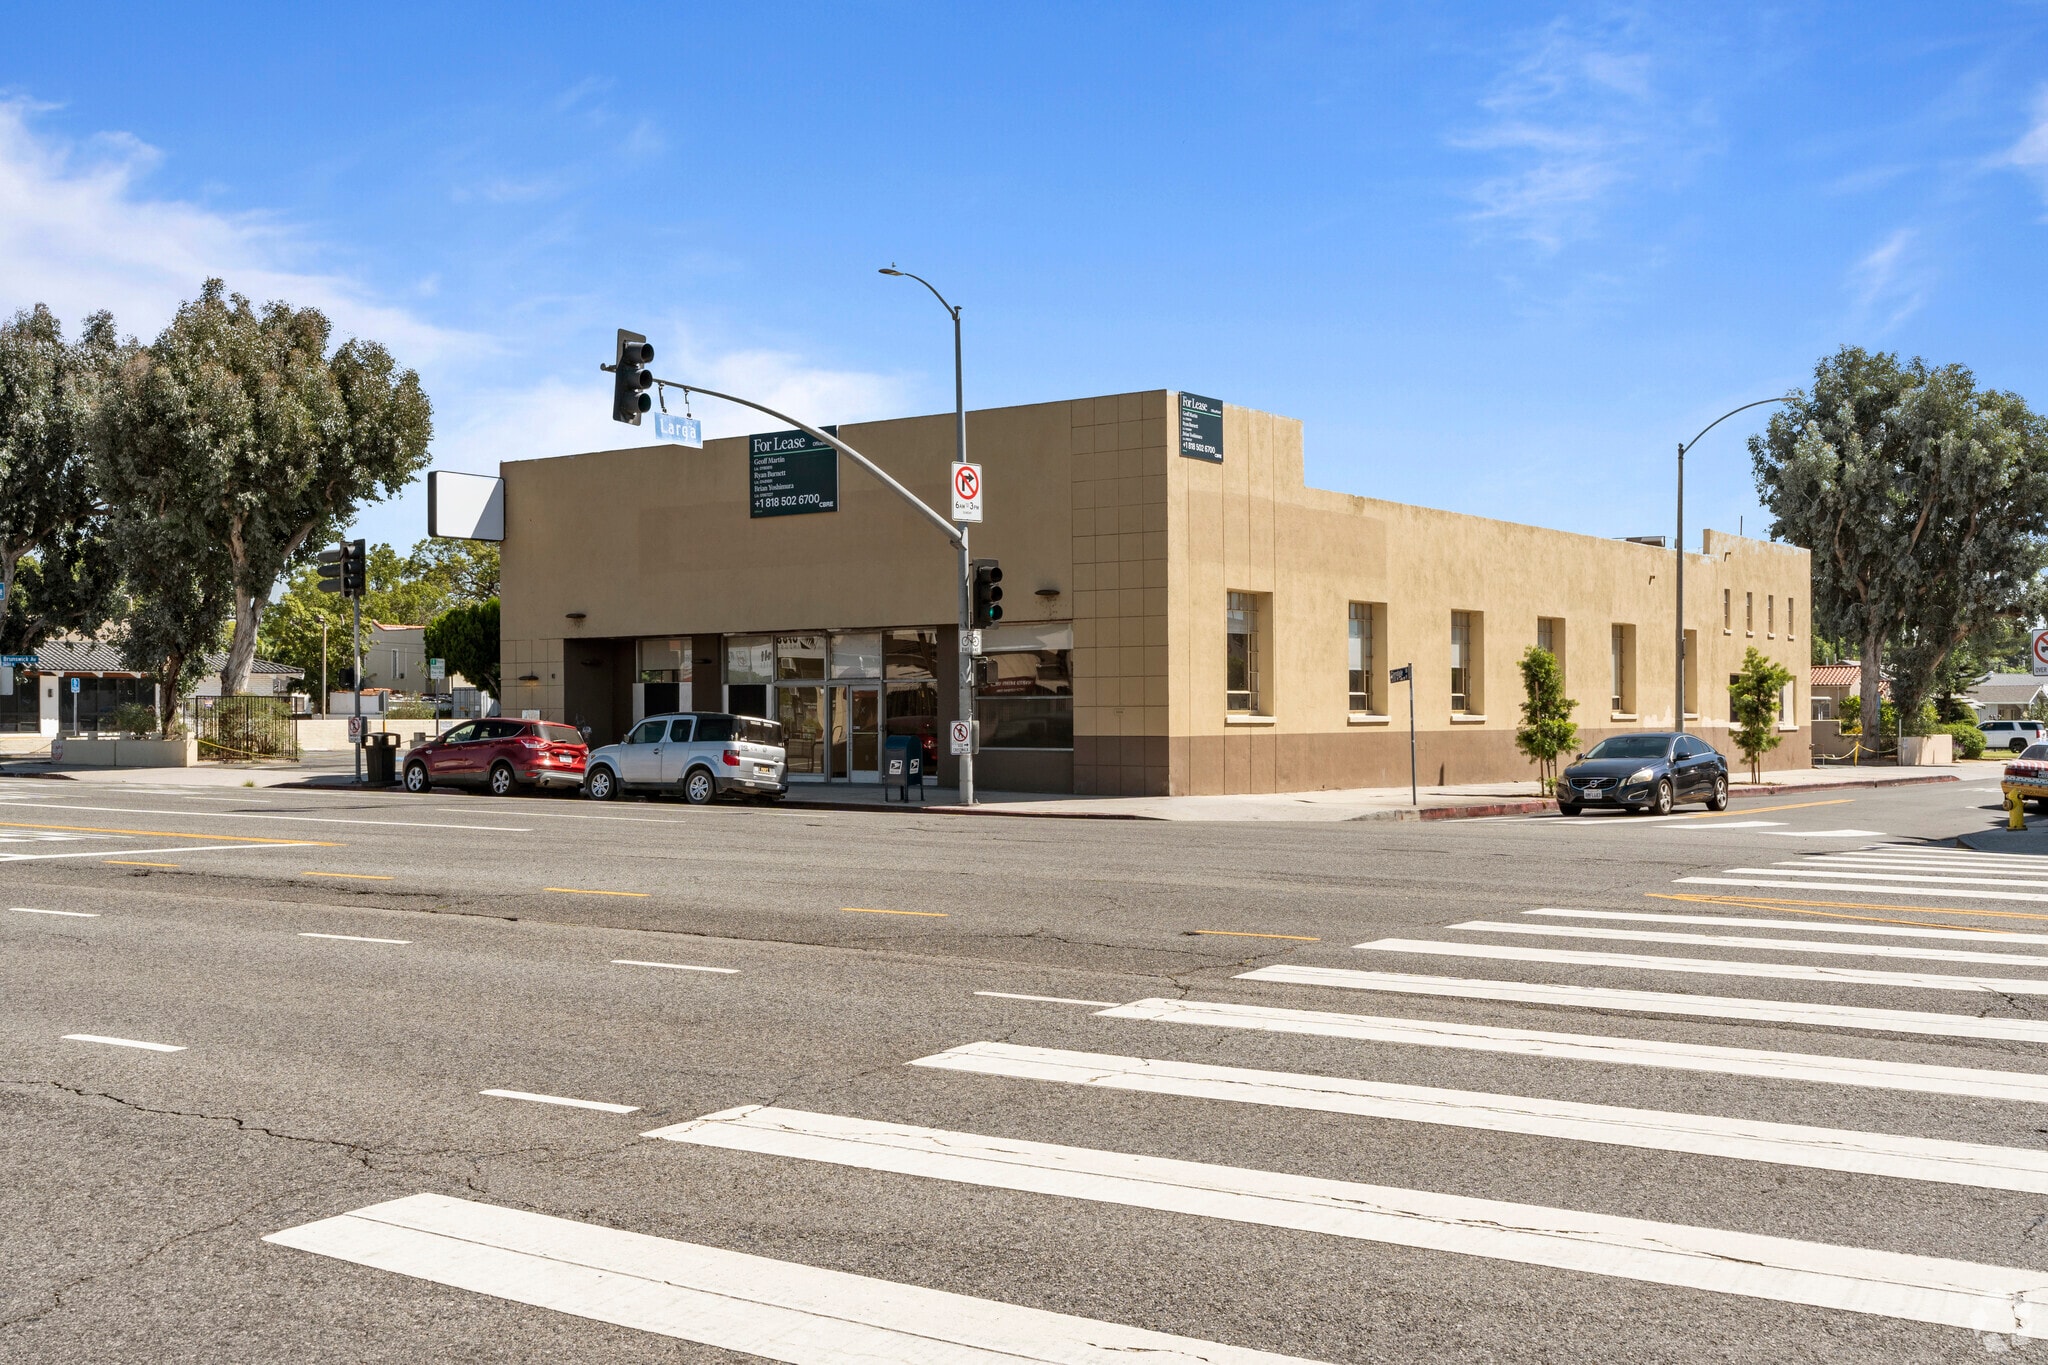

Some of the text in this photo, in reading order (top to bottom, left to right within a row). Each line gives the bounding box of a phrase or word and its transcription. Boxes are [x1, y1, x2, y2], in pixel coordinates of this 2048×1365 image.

[1182, 396, 1208, 411] For Lease
[660, 418, 696, 441] Larga
[754, 438, 772, 452] For
[774, 437, 806, 451] Lease
[768, 483, 794, 491] Yoshimura
[754, 494, 820, 508] +1 818 502 6700
